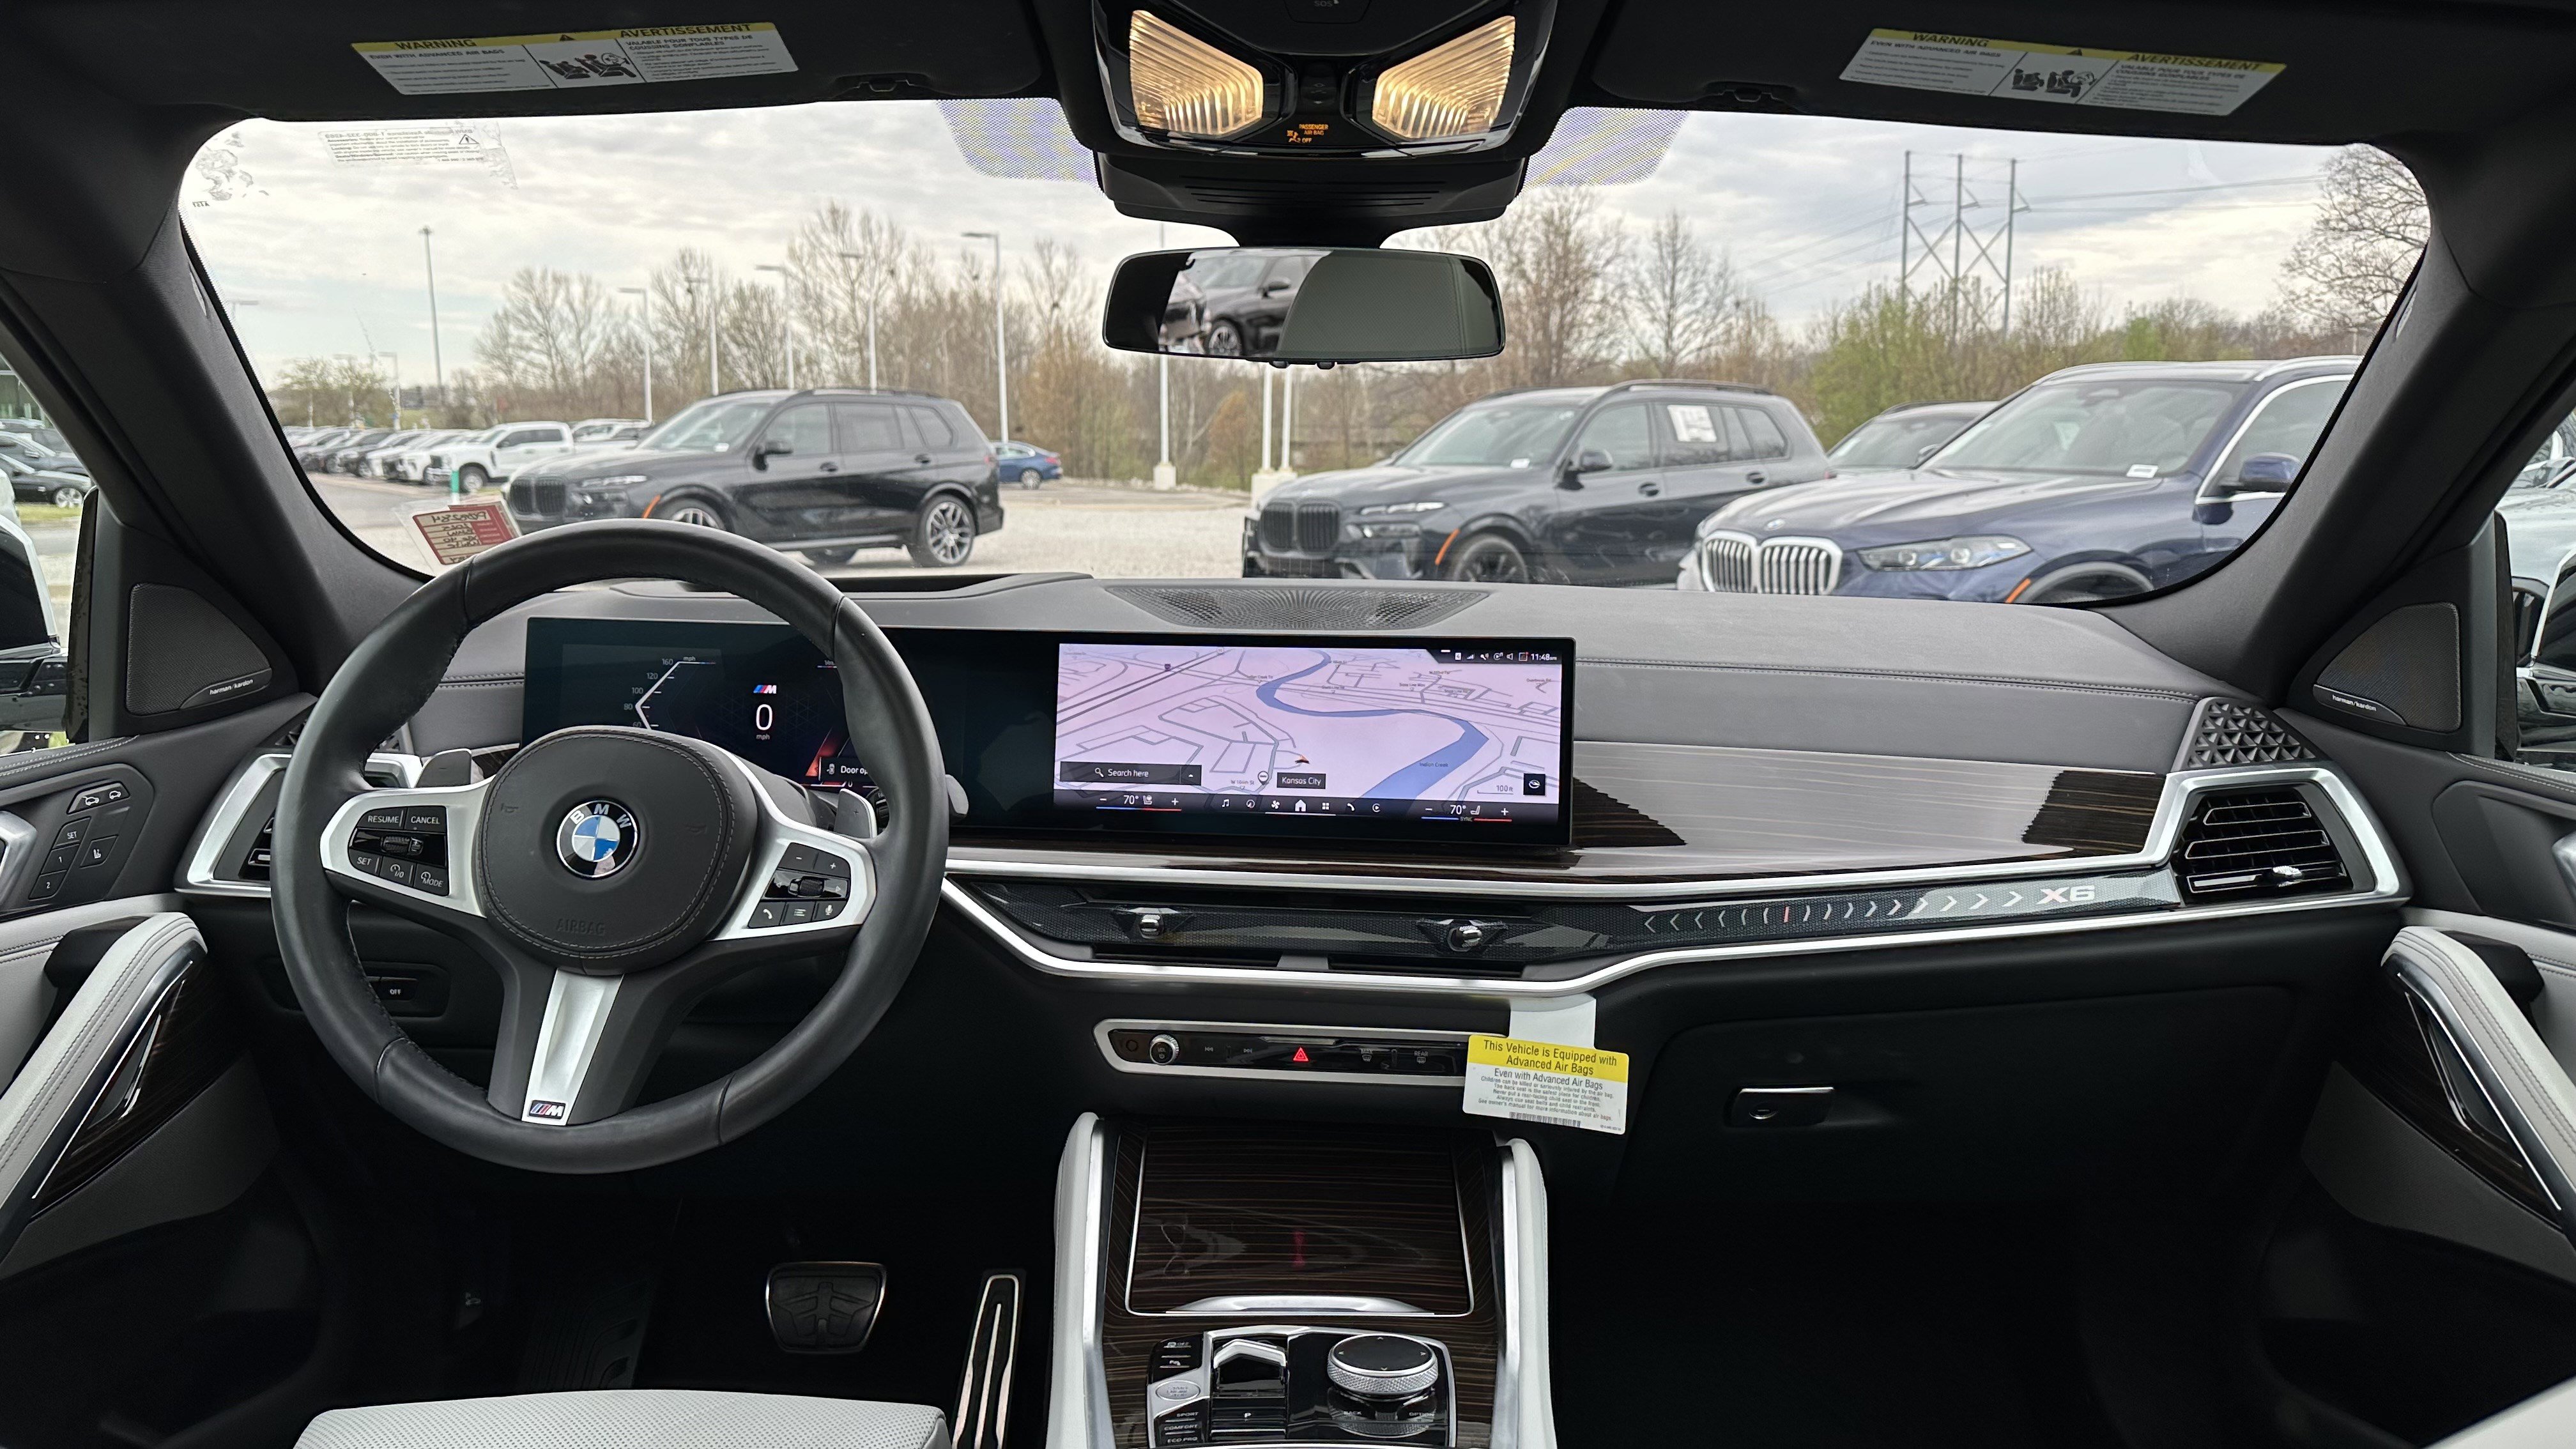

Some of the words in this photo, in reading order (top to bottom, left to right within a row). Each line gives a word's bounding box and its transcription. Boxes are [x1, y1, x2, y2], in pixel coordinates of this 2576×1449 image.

[620, 24, 751, 38] AVERTISSEMENT
[394, 39, 477, 50] WARNING
[1913, 33, 1989, 47] WARNING
[2127, 54, 2260, 71] AVERTISSEMENT
[756, 704, 773, 731] 0
[841, 765, 859, 774] Door
[1107, 769, 1131, 777] Search
[1308, 778, 1321, 786] City
[368, 815, 399, 824] RESUME
[411, 816, 440, 824] CANCEL
[570, 803, 632, 829] BMW
[67, 831, 77, 839] SET
[357, 857, 372, 866] SET
[422, 878, 444, 887] MODE
[2037, 885, 2095, 905] X6
[556, 918, 607, 935] AIRBAG
[1483, 1039, 1503, 1052] This
[1506, 1042, 1539, 1056] Vehicle
[1542, 1047, 1550, 1057] is
[1553, 1048, 1596, 1063] Equipped
[1599, 1055, 1617, 1066] with
[1506, 1055, 1552, 1070] Advanced
[1554, 1061, 1568, 1071] Air
[1571, 1063, 1594, 1077] Bags
[1494, 1068, 1512, 1078] Even
[1515, 1071, 1531, 1080] with
[1533, 1073, 1570, 1085] Advanced
[1572, 1078, 1583, 1087] Air
[1585, 1079, 1603, 1091] Bags
